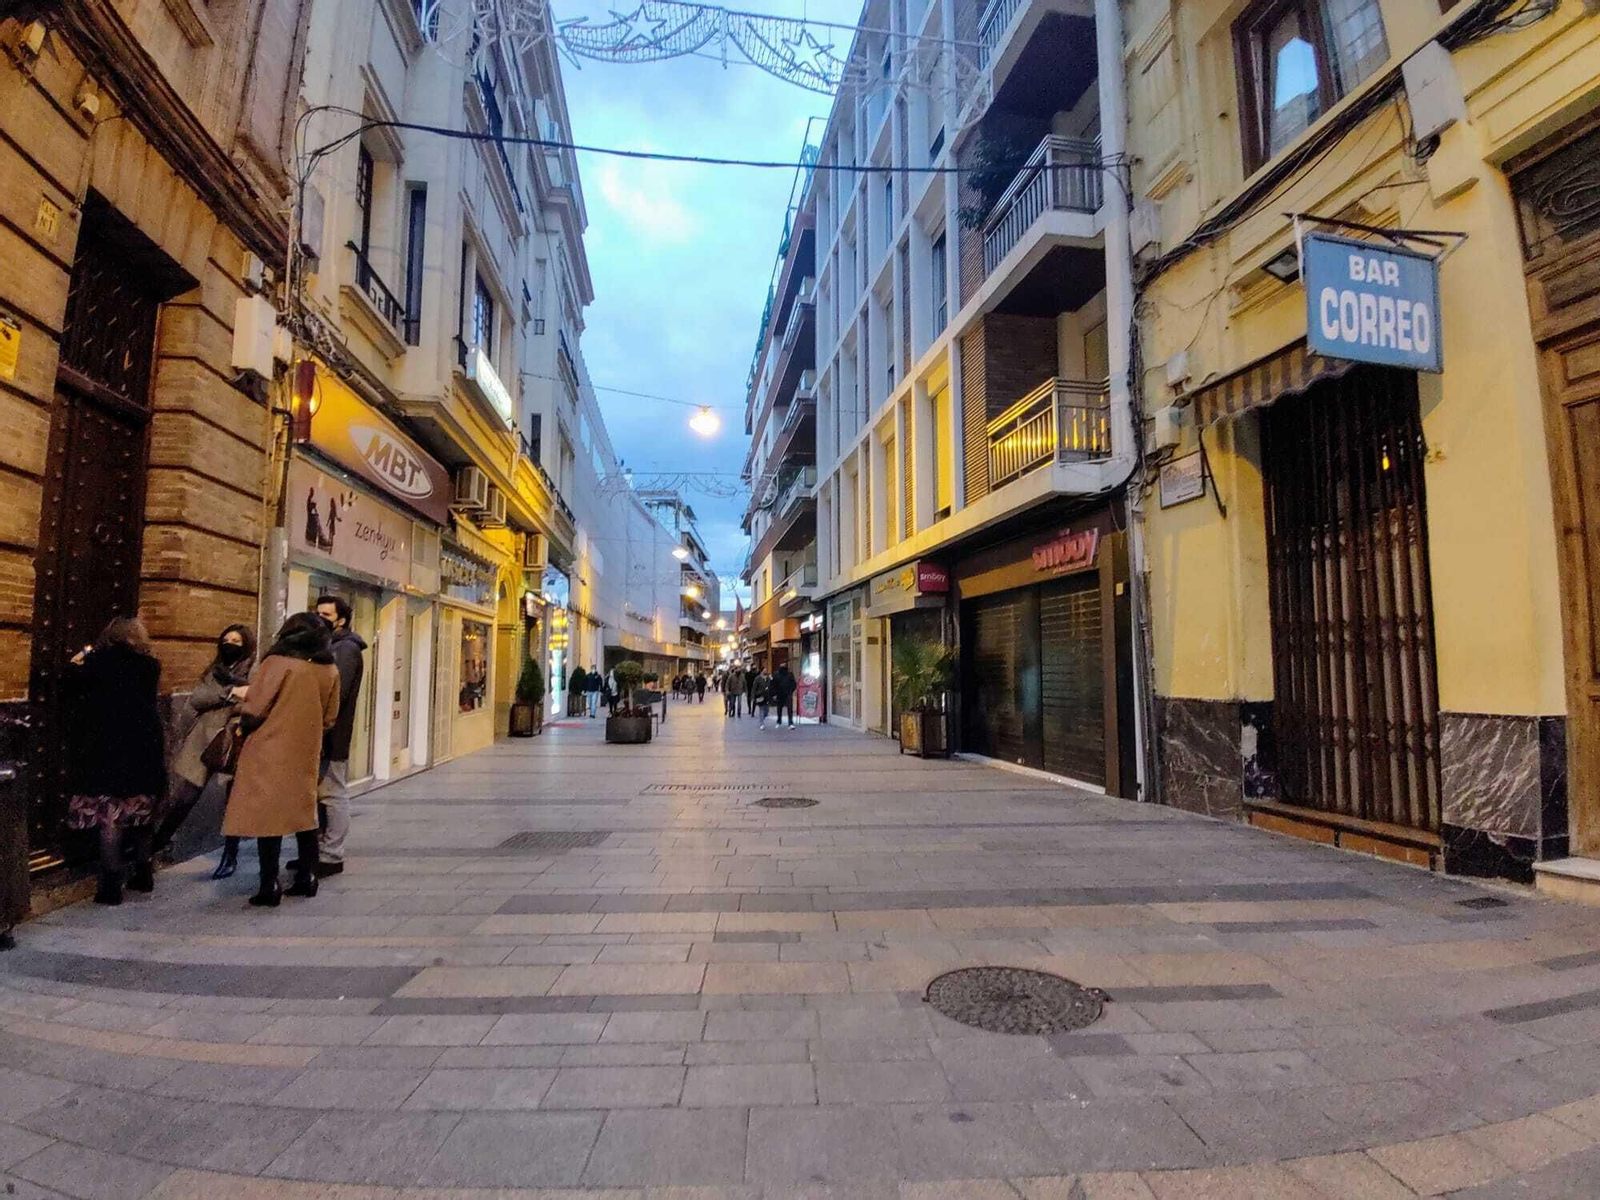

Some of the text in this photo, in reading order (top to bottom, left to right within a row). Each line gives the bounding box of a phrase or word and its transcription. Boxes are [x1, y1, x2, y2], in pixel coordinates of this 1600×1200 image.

[1349, 254, 1399, 287] BAR
[1321, 286, 1431, 354] CORREO
[365, 434, 422, 488] MBT
